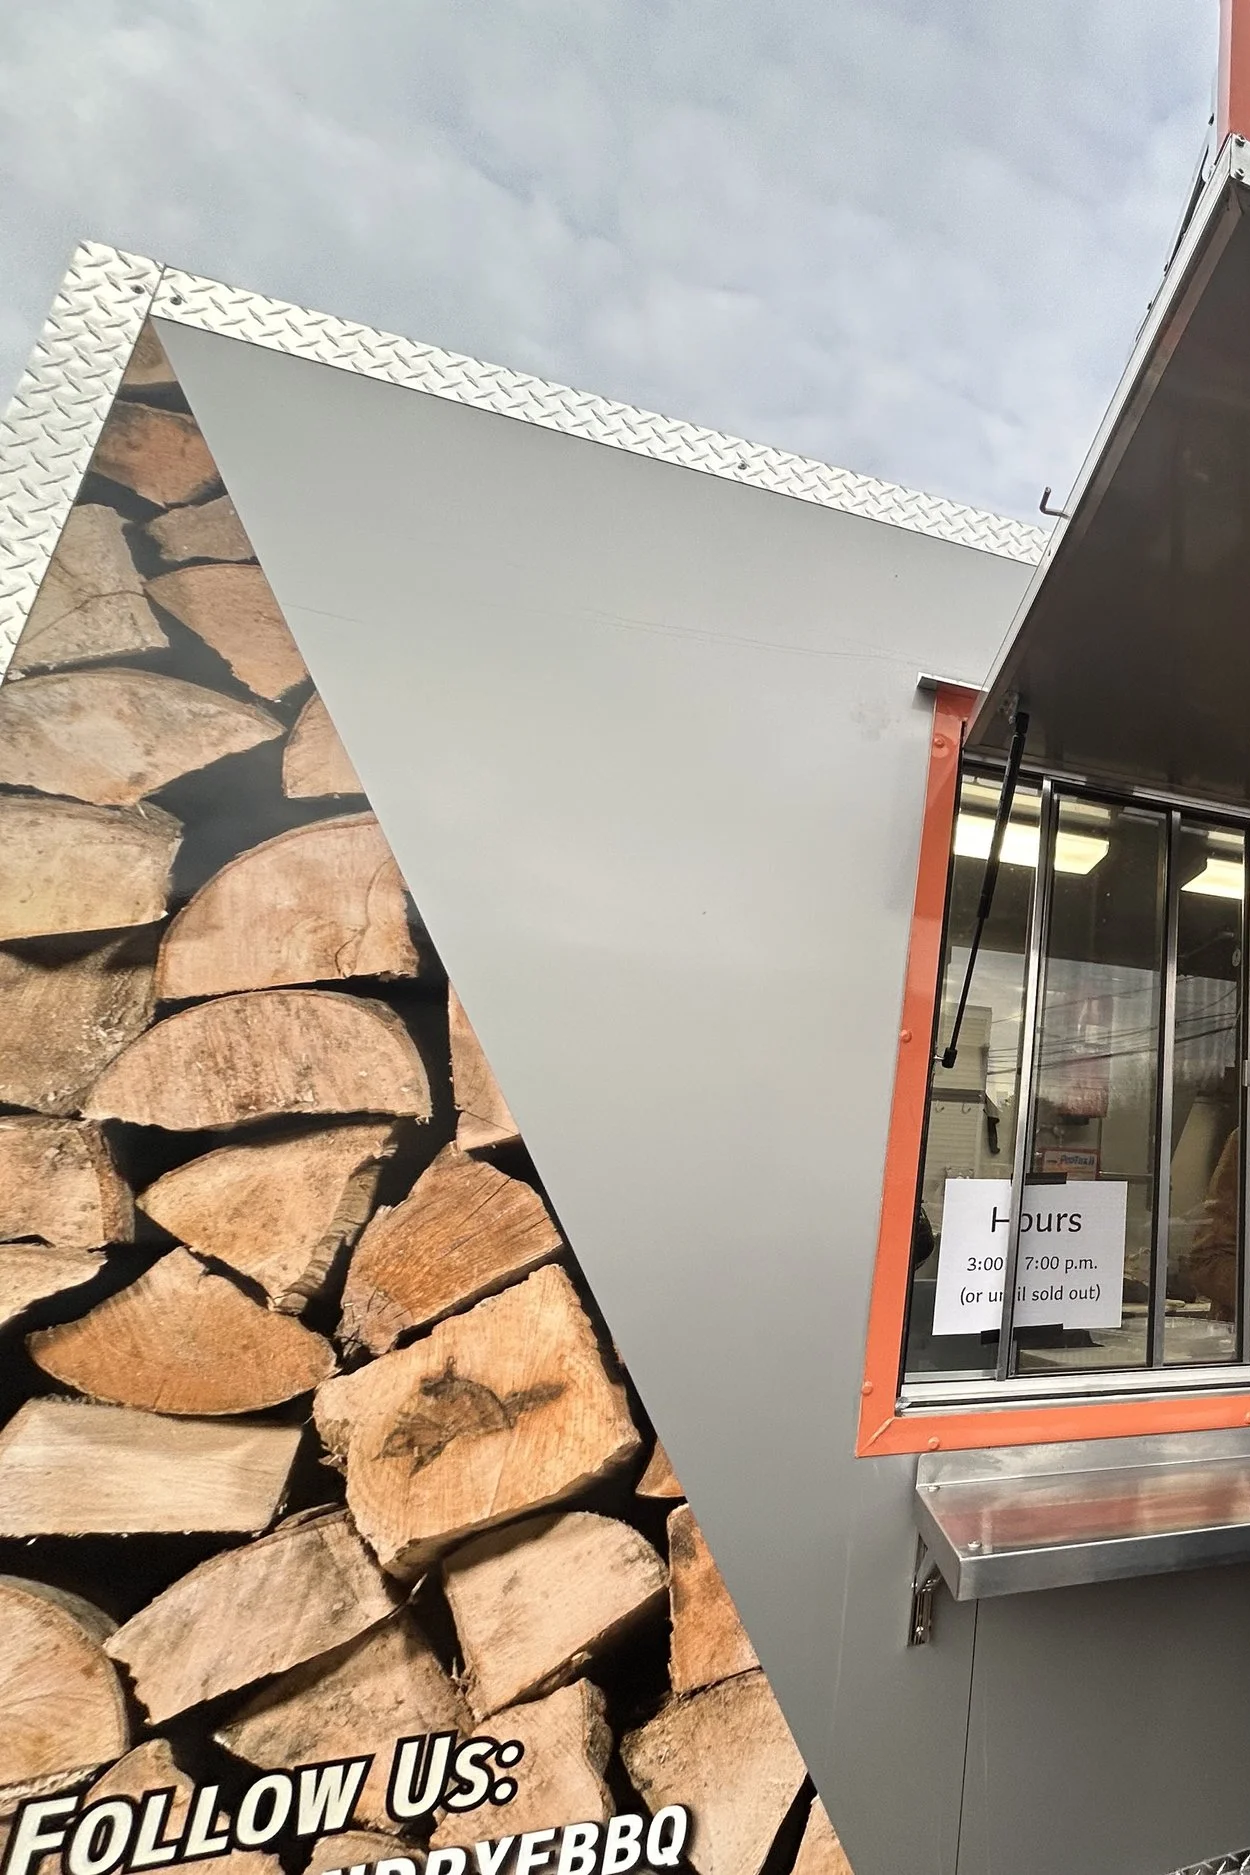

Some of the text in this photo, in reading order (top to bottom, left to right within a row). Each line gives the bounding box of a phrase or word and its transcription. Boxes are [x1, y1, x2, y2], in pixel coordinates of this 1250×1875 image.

[991, 1206, 1082, 1233] Hours
[1025, 1256, 1059, 1271] 7:00
[1064, 1257, 1098, 1274] p.m.
[960, 1284, 1101, 1306] (or uil sold out)
[3, 1730, 524, 1875] FOLLOW US:
